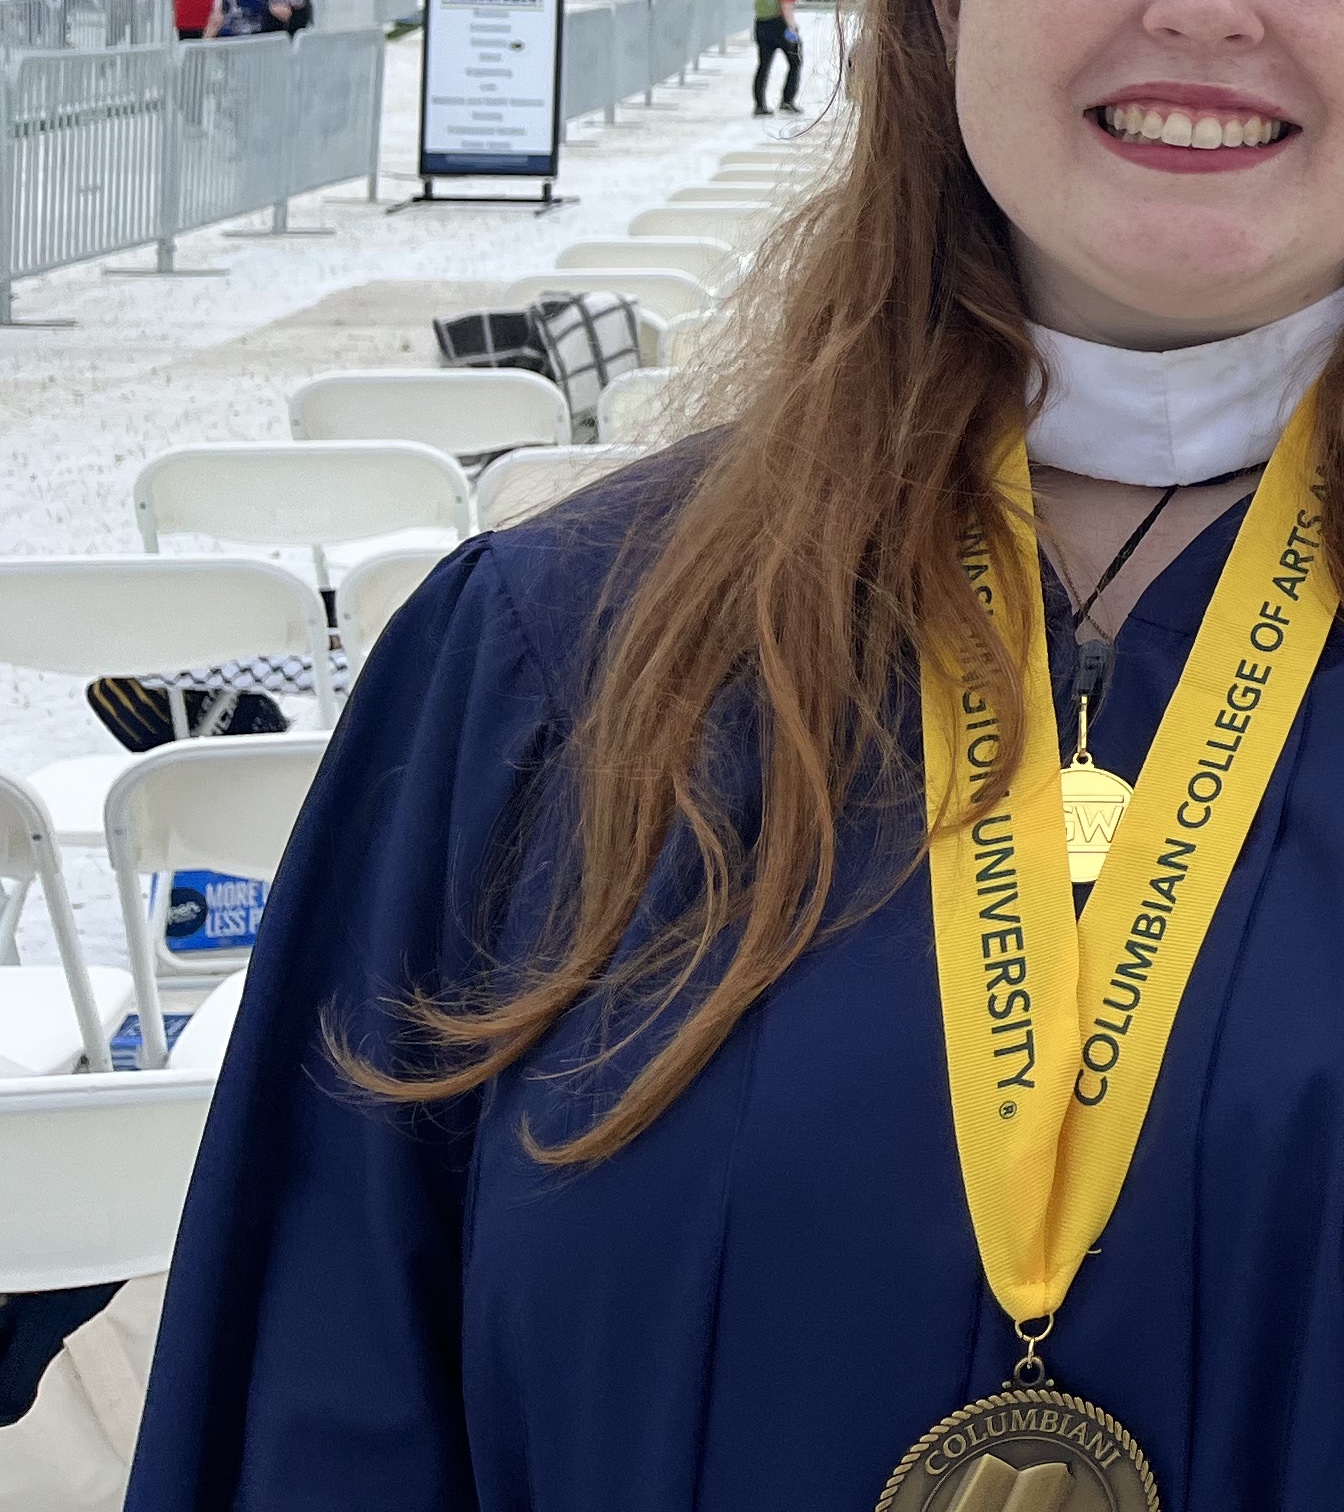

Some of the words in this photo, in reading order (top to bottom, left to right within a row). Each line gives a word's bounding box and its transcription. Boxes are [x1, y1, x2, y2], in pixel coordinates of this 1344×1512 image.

[1074, 837, 1197, 1106] COLUMBIAN
[1177, 659, 1272, 829] COLLEGE
[1250, 601, 1290, 653] OF
[1272, 509, 1323, 601] ARTS
[204, 907, 247, 938] LESS
[205, 881, 260, 909] MORE
[971, 814, 1036, 1089] UNIVERSITY
[925, 1408, 1123, 1475] COLUMBIANI
